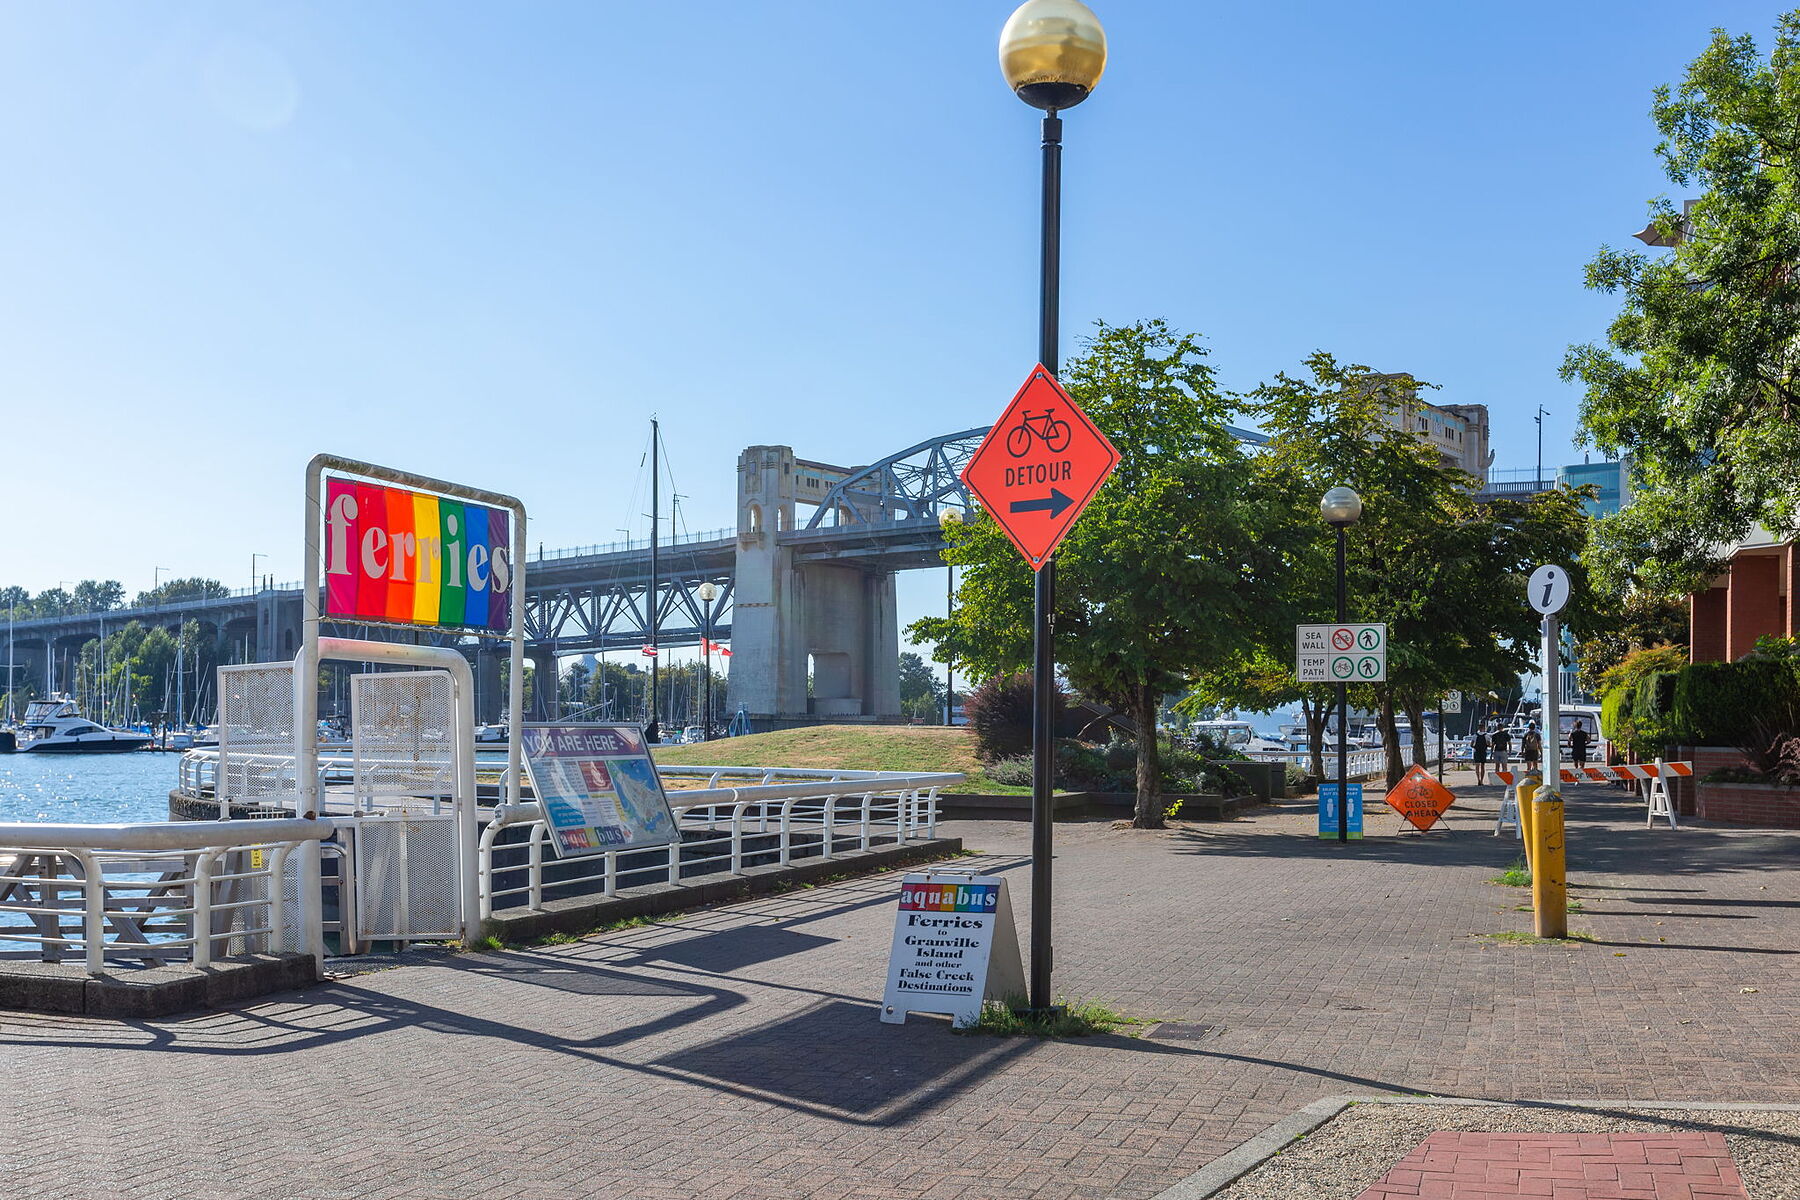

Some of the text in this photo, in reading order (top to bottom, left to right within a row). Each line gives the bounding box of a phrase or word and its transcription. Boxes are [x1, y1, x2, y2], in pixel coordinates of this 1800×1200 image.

[1005, 461, 1072, 487] DETOUR
[327, 494, 510, 593] ferries
[1541, 571, 1555, 608] i
[1050, 625, 1054, 634] 7
[1305, 632, 1322, 640] SEA
[1302, 658, 1325, 666] TEMP
[1303, 668, 1325, 676] PATH
[524, 735, 618, 752] YOU ARE HERE
[1404, 800, 1438, 808] CLOSED
[1406, 809, 1438, 817] AHEAD
[901, 886, 996, 909] aquabus
[908, 914, 983, 929] Ferries
[904, 935, 980, 948] Granville
[916, 948, 964, 958] Island
[935, 960, 962, 968] other
[900, 968, 975, 981] False Creek
[897, 980, 973, 993] Destinations
